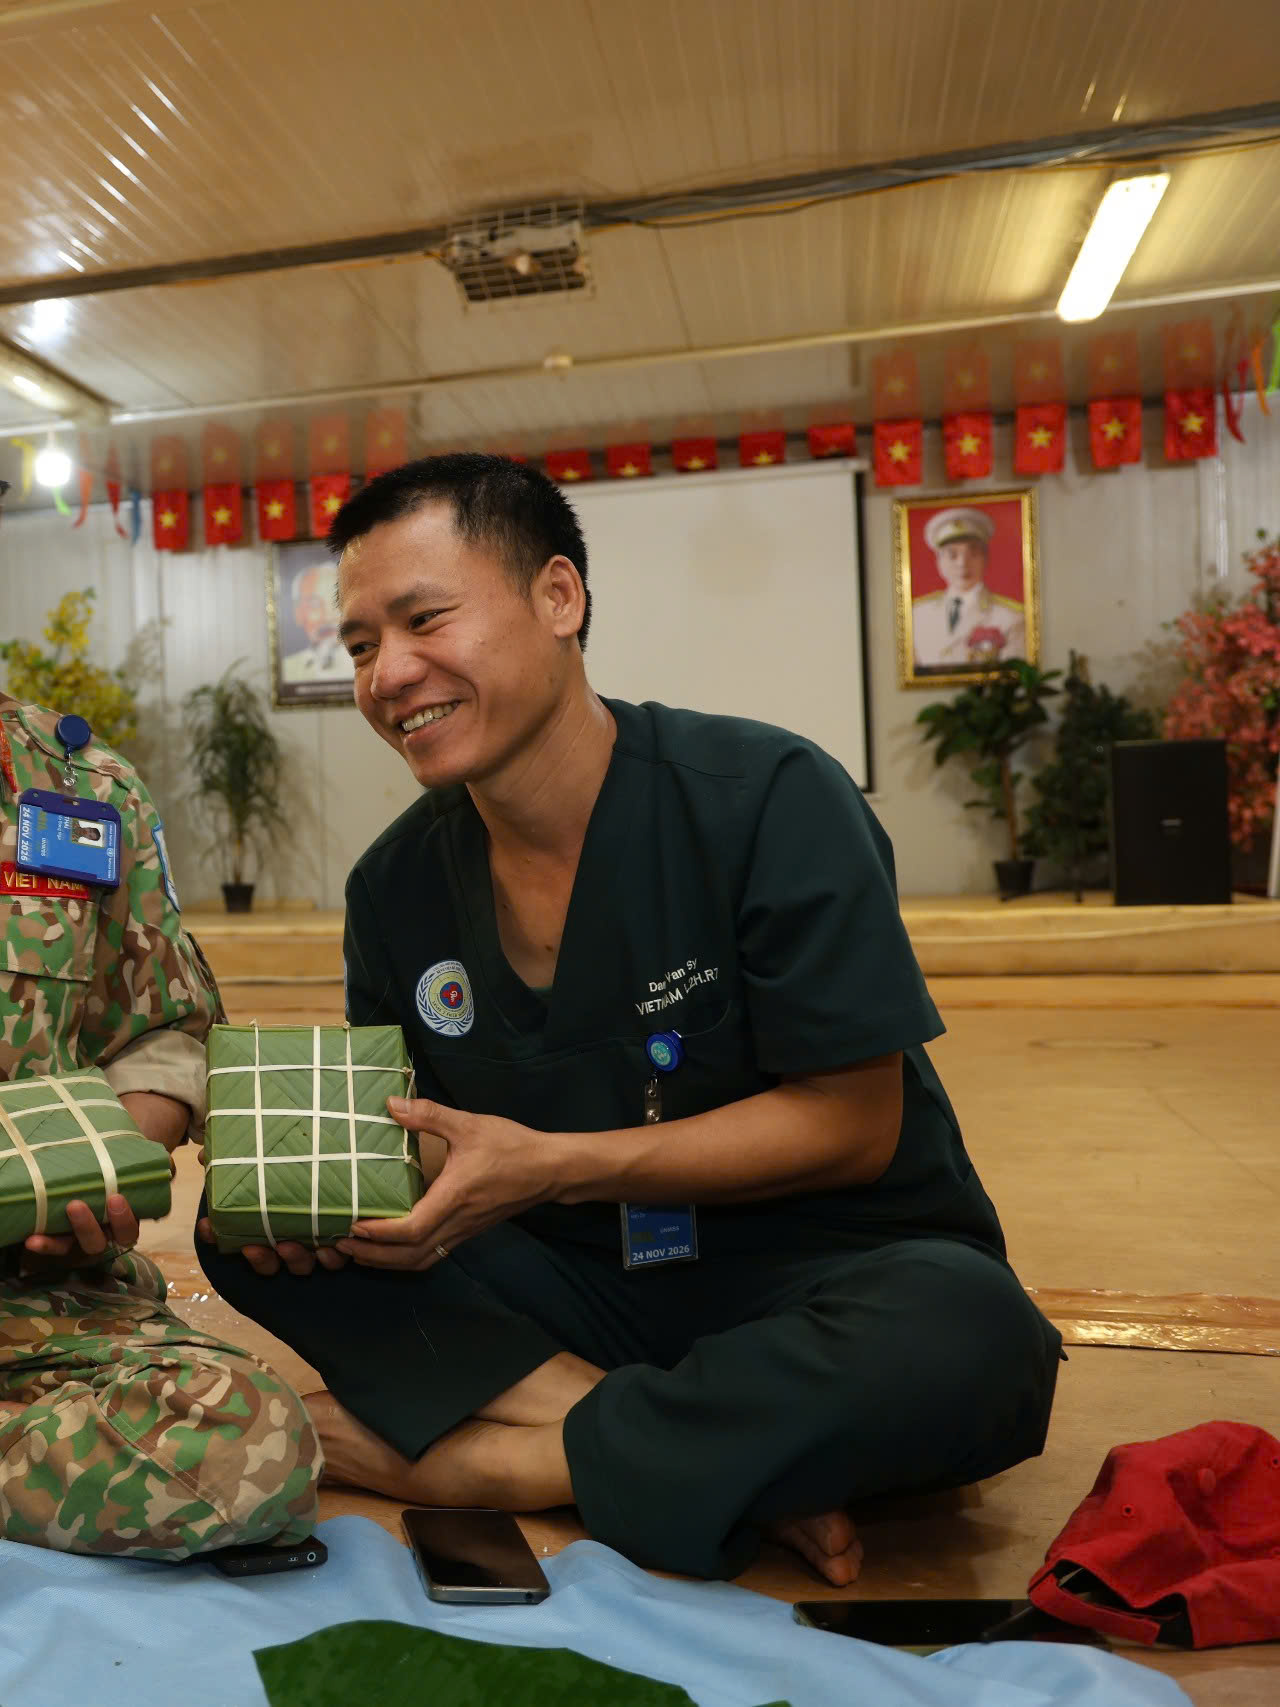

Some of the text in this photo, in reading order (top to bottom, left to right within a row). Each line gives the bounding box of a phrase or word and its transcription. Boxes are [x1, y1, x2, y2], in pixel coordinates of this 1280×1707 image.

[20, 806, 32, 861] 24 NOV 2026
[3, 871, 40, 889] VIET
[664, 967, 686, 983] Van
[632, 1244, 690, 1261] 24 NOV 2026
